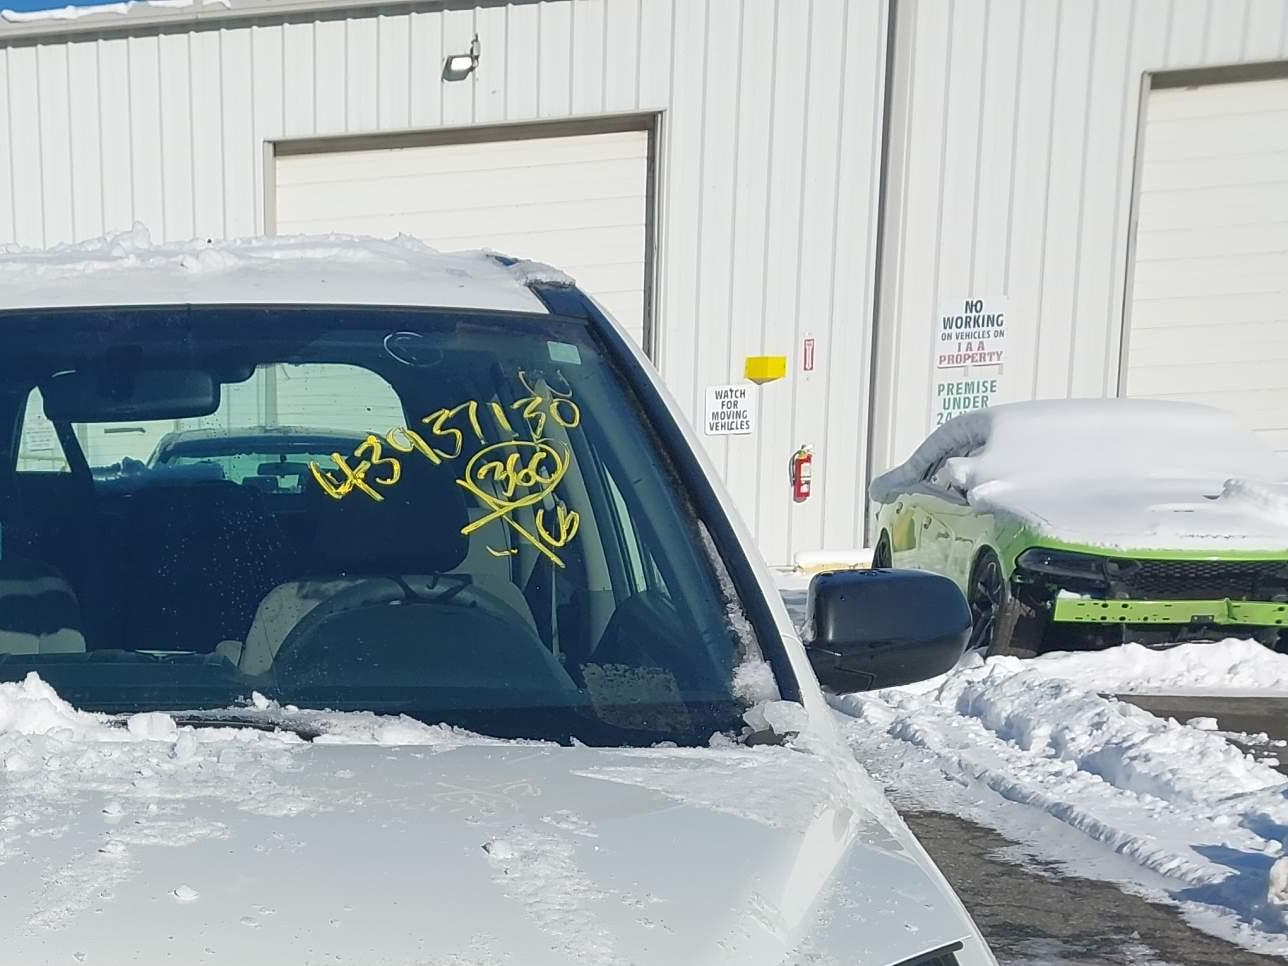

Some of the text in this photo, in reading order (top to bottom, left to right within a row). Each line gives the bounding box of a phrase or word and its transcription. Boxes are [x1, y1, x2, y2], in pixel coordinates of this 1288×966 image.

[964, 299, 984, 314] NO
[942, 313, 1004, 330] WORKING
[941, 329, 1005, 341] ON VEHICLES ON
[938, 351, 1004, 365] PROPERTY
[715, 388, 746, 400] WATCH
[937, 380, 997, 396] PREMISE
[721, 400, 738, 410] FOR
[942, 395, 989, 411] UNDER
[712, 410, 748, 421] MOVING
[709, 420, 750, 431] VEHICLES
[309, 397, 580, 501] 43937130
